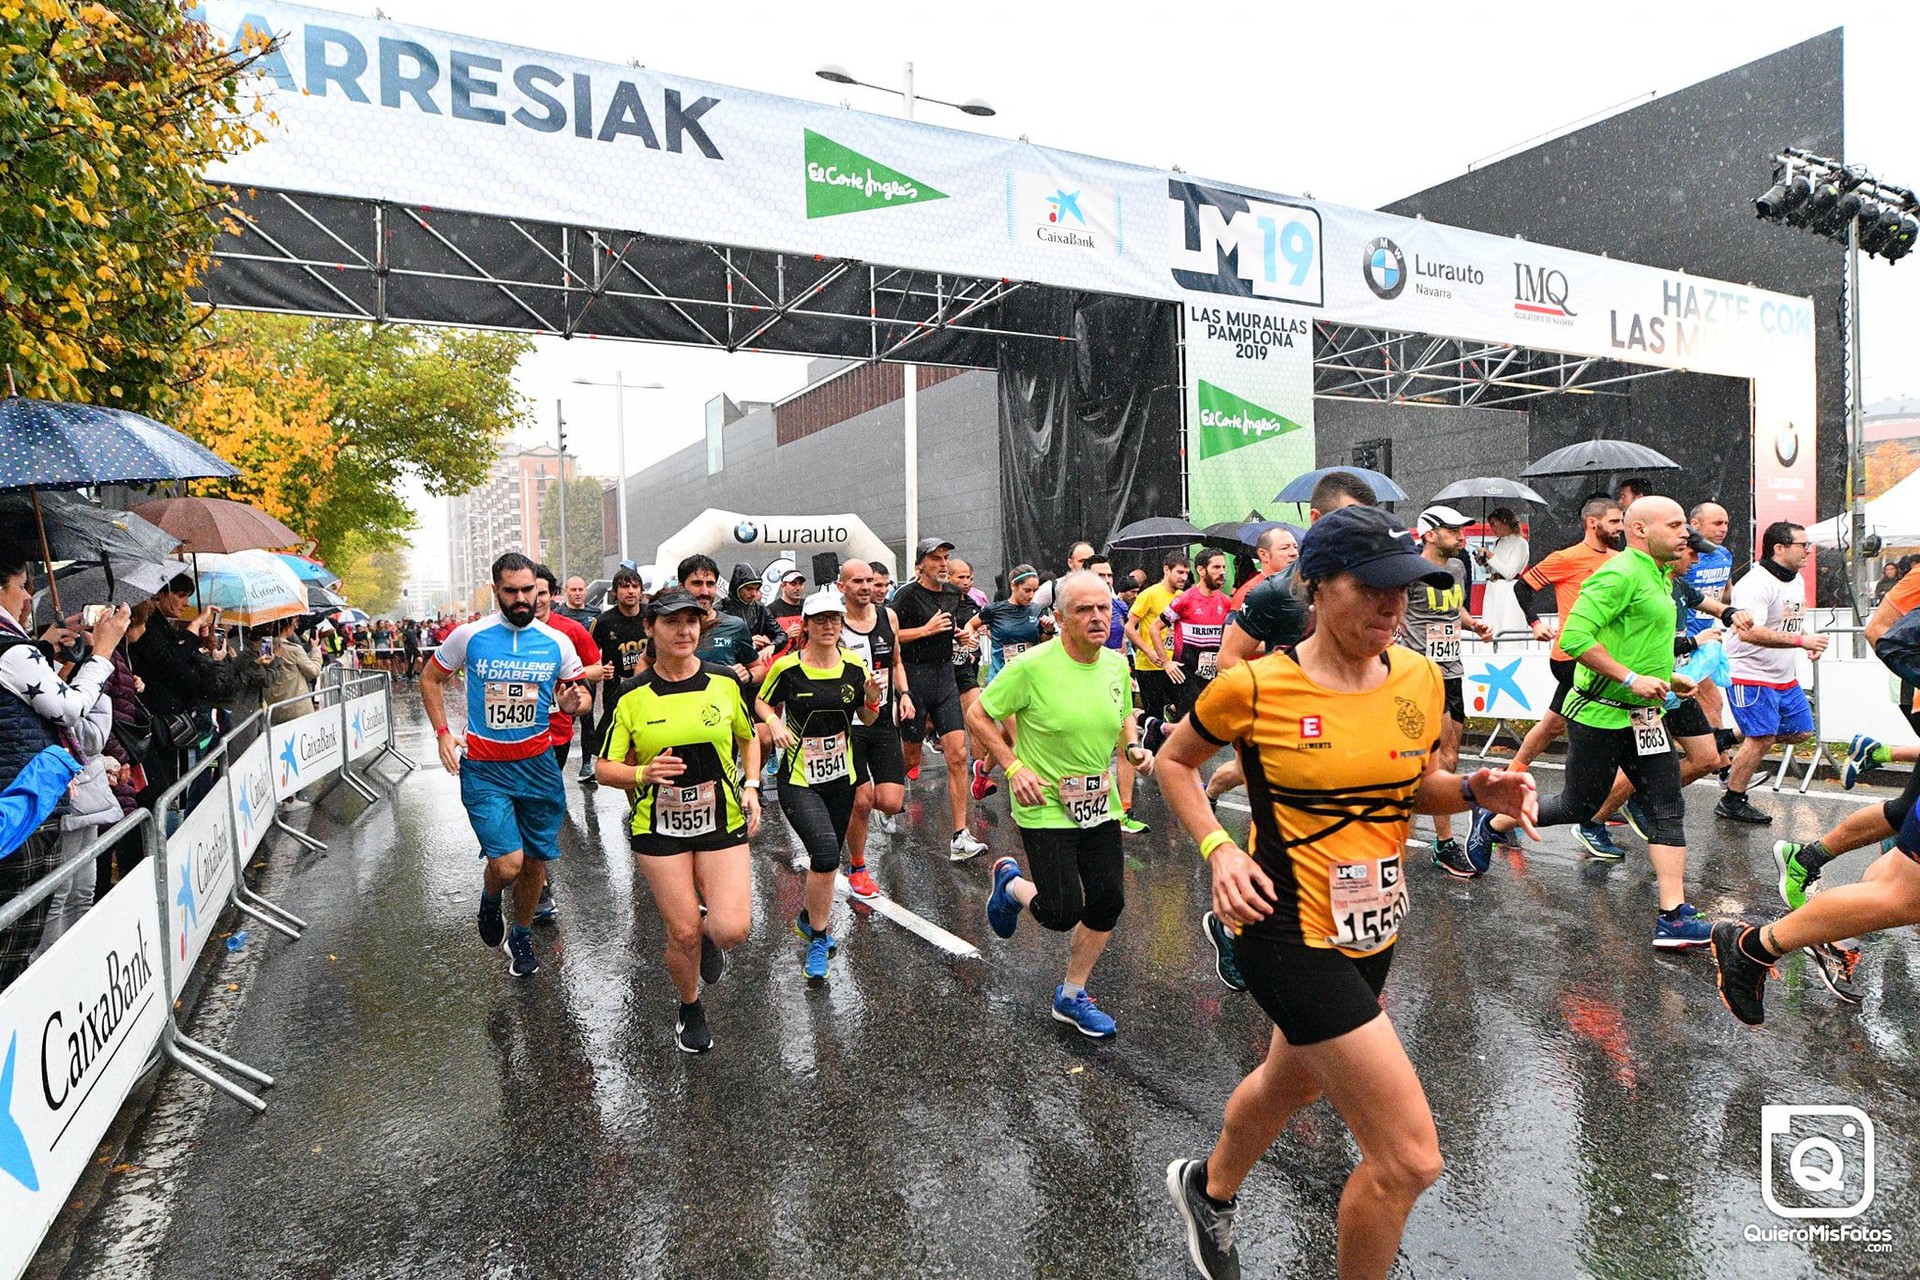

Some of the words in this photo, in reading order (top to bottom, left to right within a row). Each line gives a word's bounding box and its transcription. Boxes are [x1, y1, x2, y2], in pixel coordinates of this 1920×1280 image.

[190, 3, 724, 161] ARRESIAK
[808, 162, 824, 183] El
[825, 166, 864, 190] Corte
[865, 168, 917, 200] Inglés
[1037, 227, 1095, 249] CaixaBank
[1367, 238, 1402, 260] BMW
[1415, 254, 1484, 285] Lurauto
[1416, 284, 1452, 299] Navarra
[1513, 262, 1578, 316] IMQ
[1191, 306, 1221, 324] LAS
[1227, 311, 1307, 335] MURALLAS
[1663, 280, 1749, 325] HAZTE
[1760, 300, 1811, 339] CON
[1207, 324, 1293, 348] PAMPLONA
[1610, 309, 1665, 355] LAS
[1236, 344, 1268, 360] 2019
[1200, 409, 1215, 426] El
[1215, 411, 1242, 429] Corte
[764, 523, 848, 544] Lurauto
[1430, 641, 1460, 657] 15412
[488, 669, 553, 681] DIABETES
[488, 704, 534, 724] 15430
[301, 723, 337, 761] CaixaBank
[808, 752, 845, 778] 15541
[661, 806, 711, 830] 15551
[1065, 794, 1108, 823] 15542
[197, 811, 228, 895] CaixaBank
[41, 919, 152, 1111] CaixaBank
